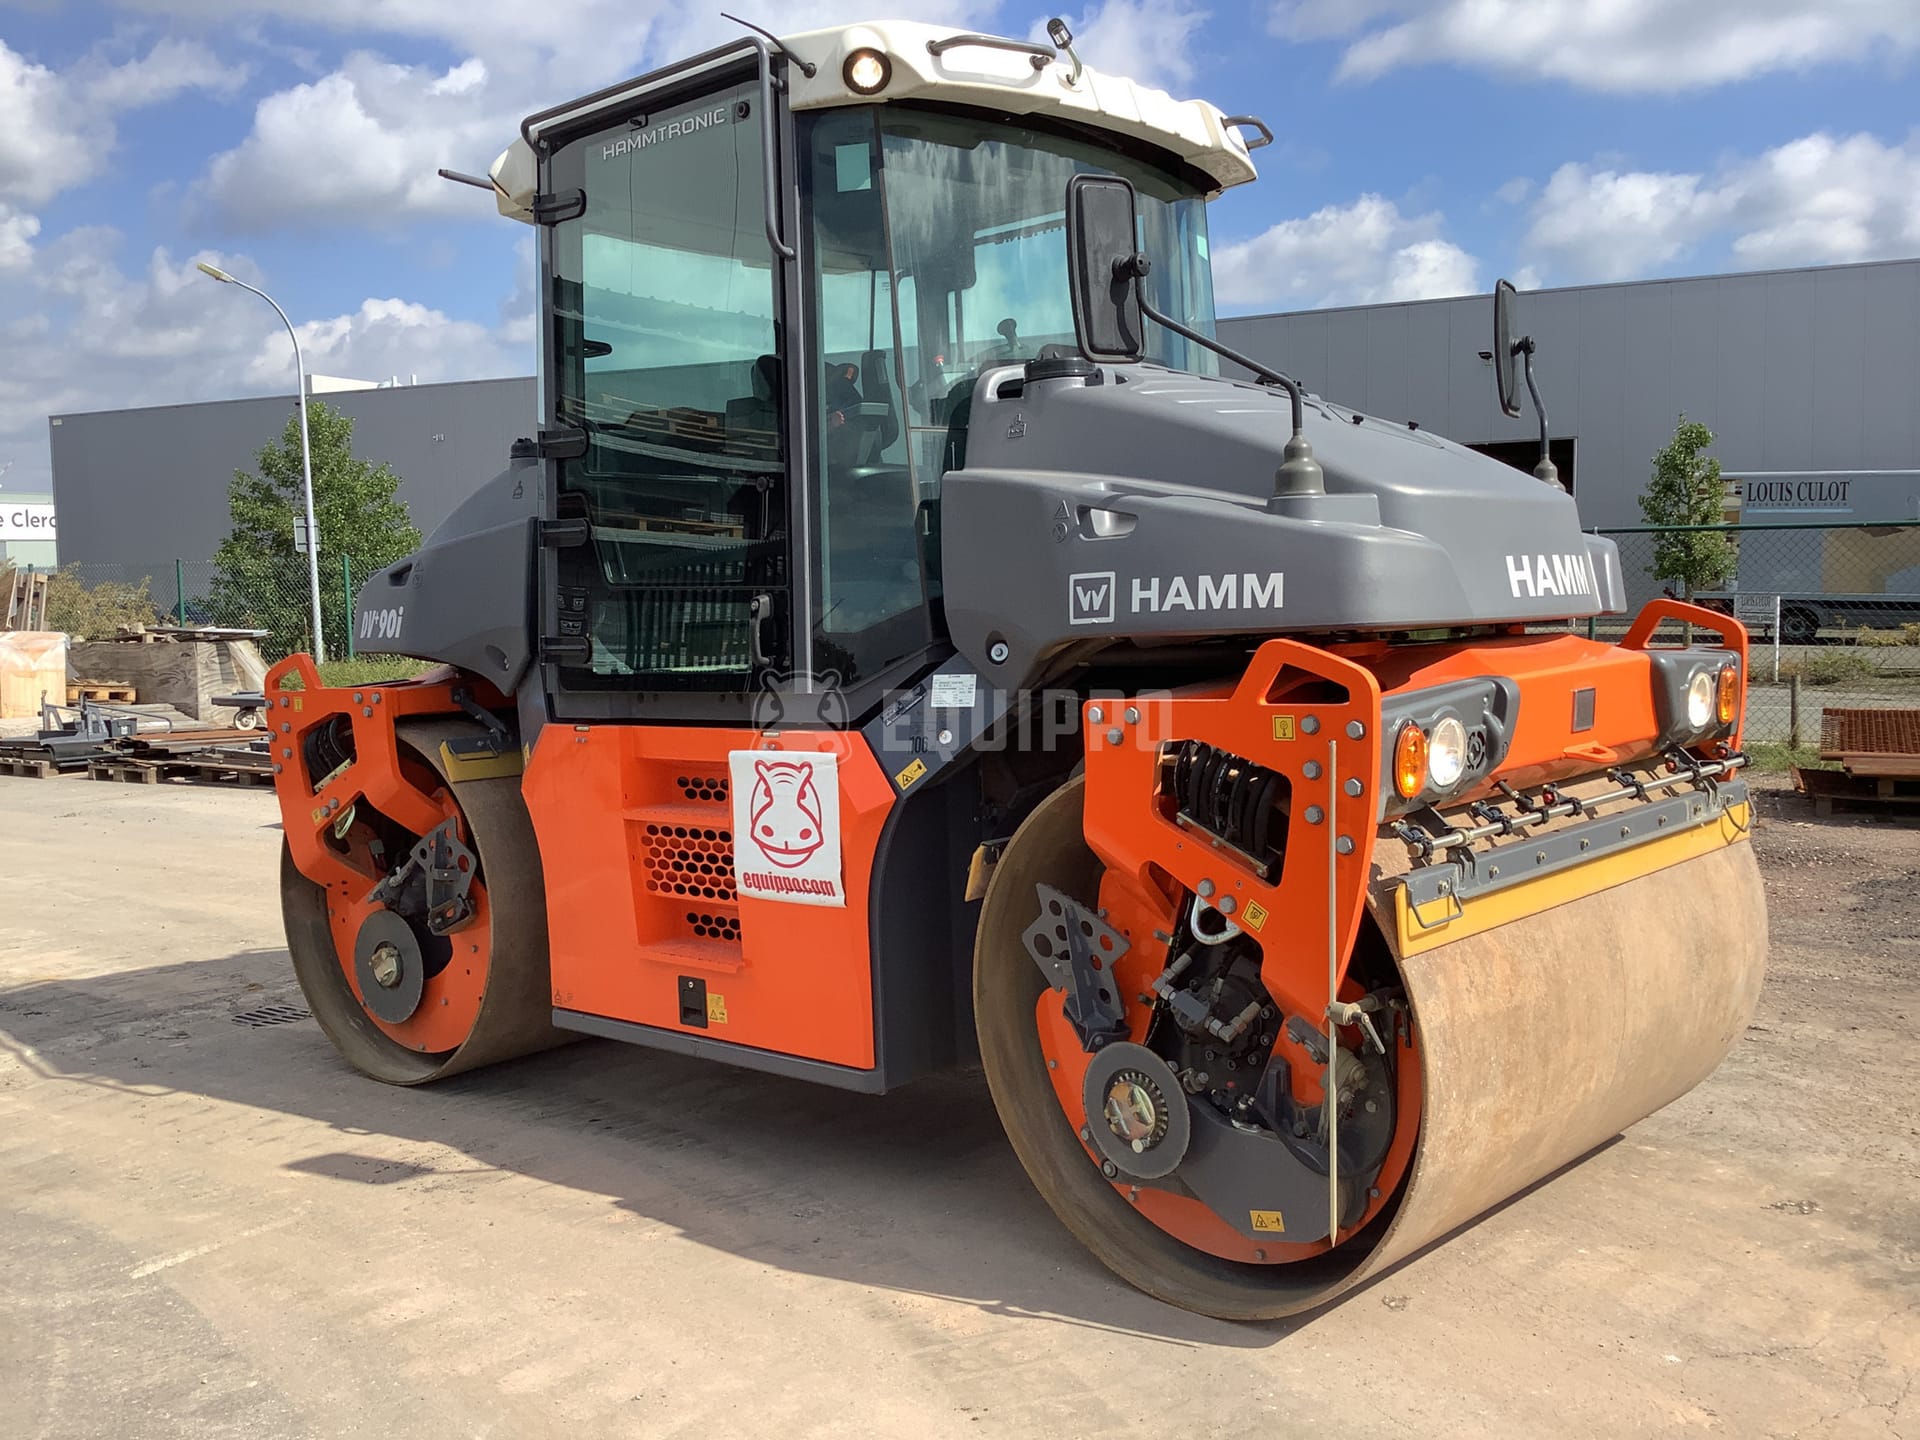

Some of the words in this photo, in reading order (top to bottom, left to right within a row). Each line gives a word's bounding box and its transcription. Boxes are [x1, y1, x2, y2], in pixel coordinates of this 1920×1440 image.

[603, 108, 725, 161] HAMMTRONIC
[1747, 481, 1793, 502] LOUIS
[1797, 480, 1850, 502] CULOT
[1131, 572, 1285, 613] HAMM
[1505, 554, 1591, 598] HAMM
